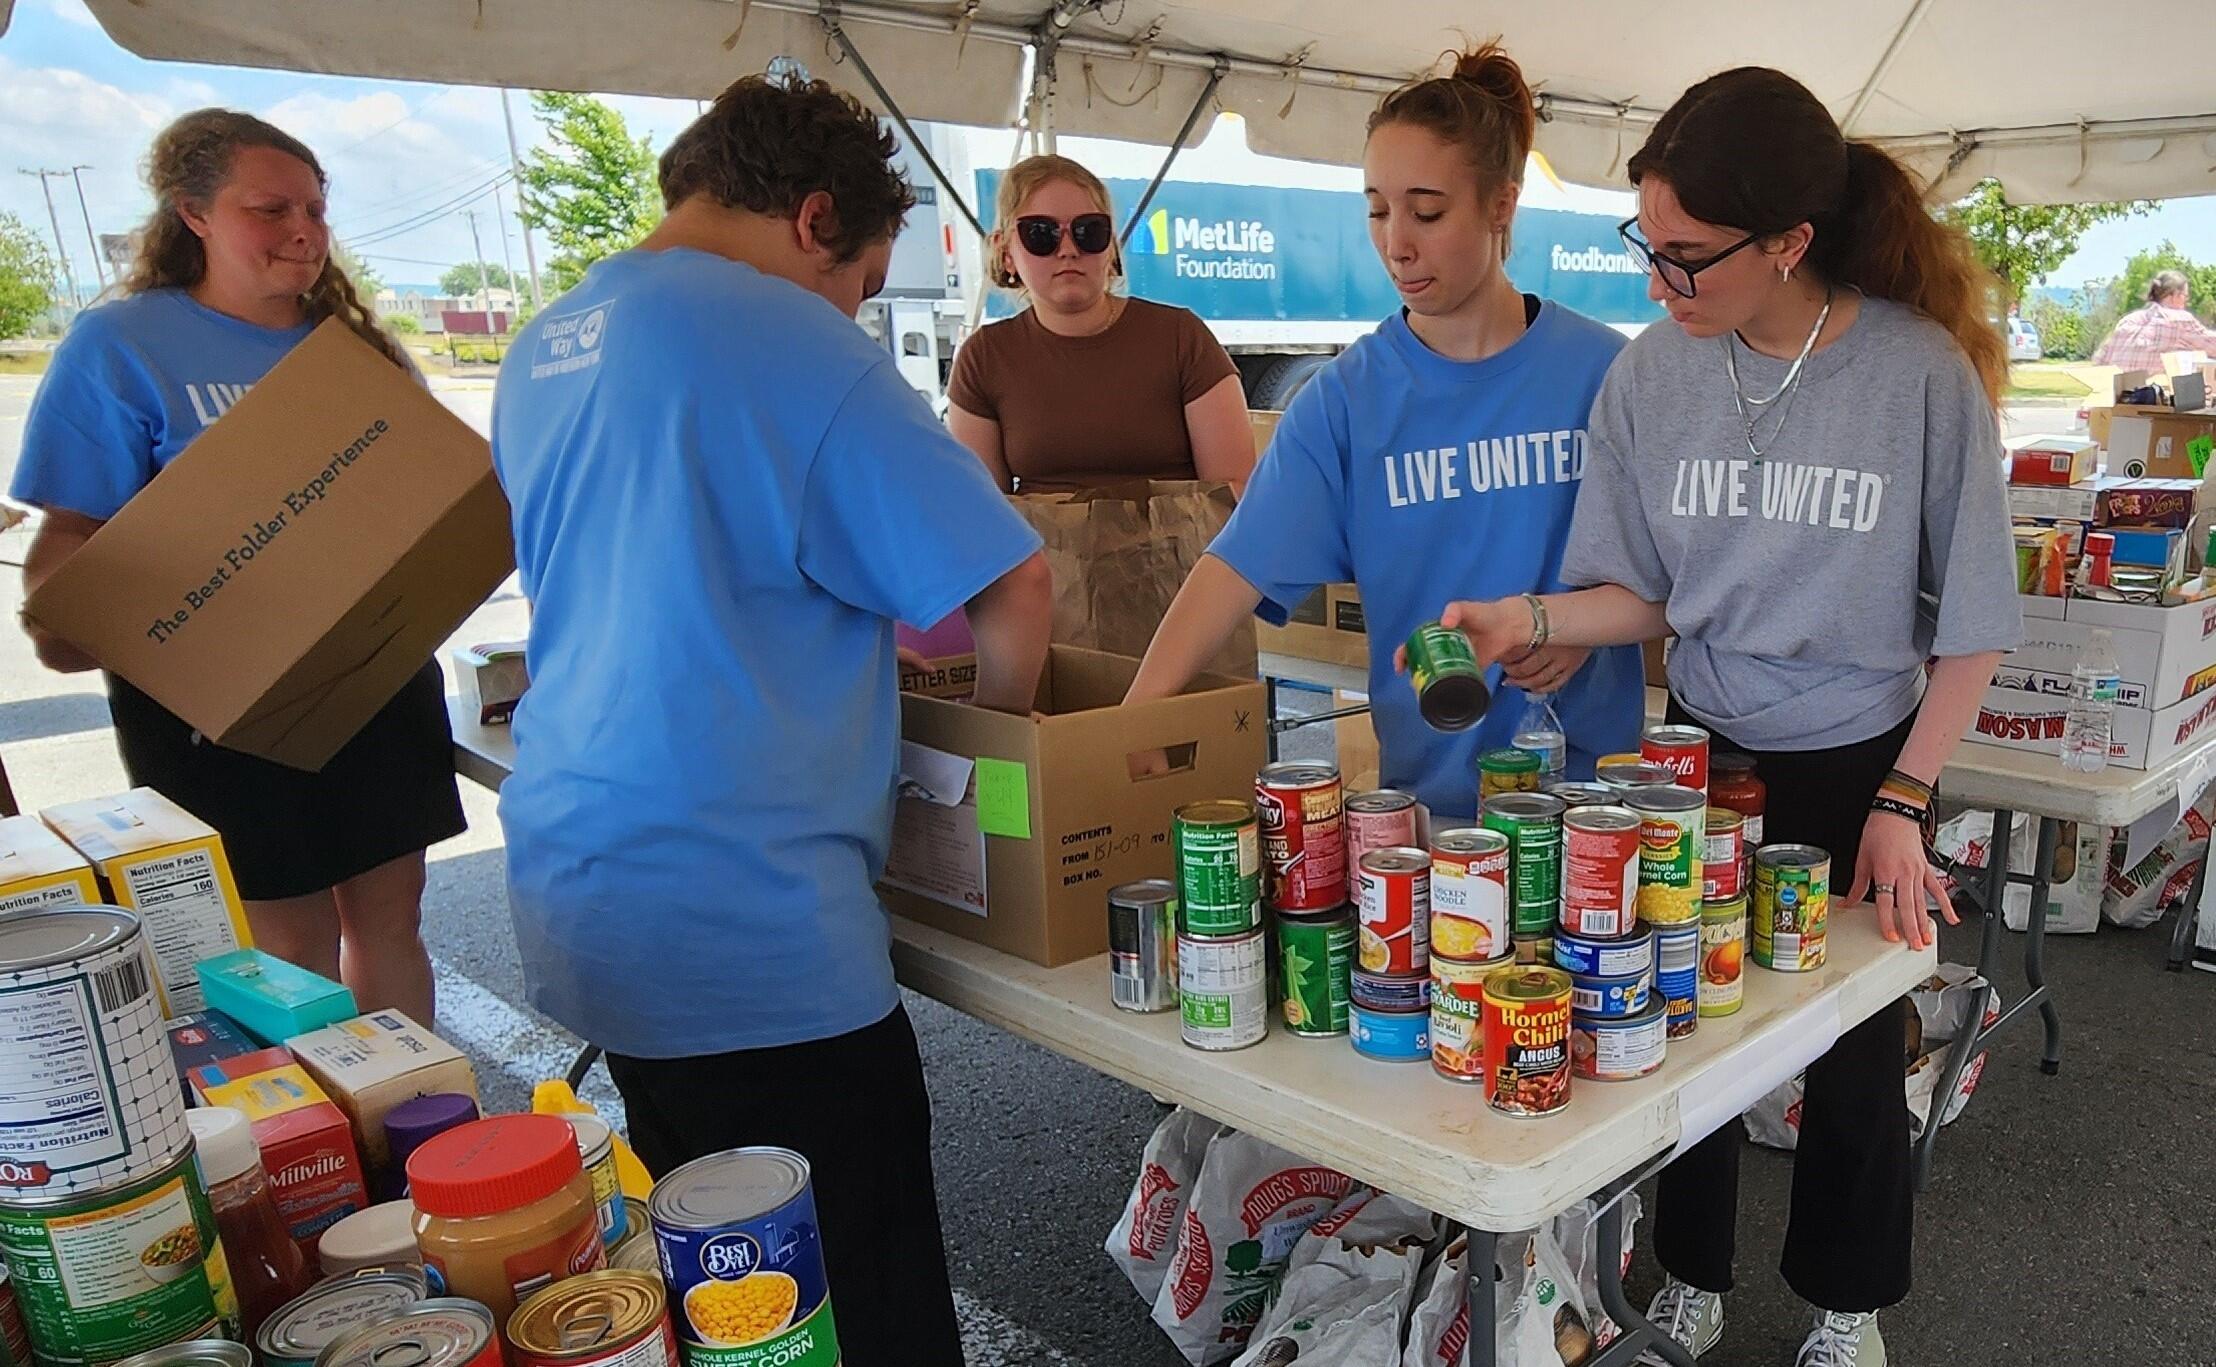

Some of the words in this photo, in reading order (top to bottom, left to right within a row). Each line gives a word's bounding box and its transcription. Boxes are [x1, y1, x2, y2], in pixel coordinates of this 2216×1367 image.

[1174, 217, 1275, 253] MetLife
[1176, 254, 1276, 281] Foundation
[185, 384, 254, 425] LIV
[1384, 447, 1461, 507] LIVE
[1467, 429, 1588, 493] UNITED
[1671, 459, 1749, 517] LIVE
[1760, 461, 1885, 532] UNITED
[147, 608, 189, 644] The
[184, 567, 231, 611] Best
[223, 511, 287, 572] Folder
[283, 418, 389, 517] Experience
[900, 670, 947, 692] ETTER
[1975, 711, 2067, 740] MASON
[1061, 825, 1112, 845] CONTENTS
[1152, 833, 1165, 844] TO
[1216, 831, 1237, 839] Facts
[1654, 828, 1679, 837] Monte
[130, 859, 175, 877] Nutrition
[177, 853, 204, 868] Facts
[1062, 851, 1089, 865] FROM
[1643, 861, 1675, 872] Whole
[193, 879, 213, 892] 160
[1063, 873, 1083, 886] BOX
[1085, 868, 1102, 881] NO.
[1663, 871, 1687, 880] Corn
[0, 895, 40, 911] utrition
[42, 887, 73, 900] Facts
[139, 892, 175, 906] Calories
[1431, 990, 1479, 1018] YARDEE
[1501, 999, 1570, 1027] Hormel
[1513, 1022, 1563, 1046] Chili
[1519, 1046, 1561, 1062] ANGUS
[45, 1090, 100, 1109] Calories
[40, 1127, 109, 1149] Nutrition
[269, 1153, 347, 1189] Millville
[1247, 1175, 1296, 1222] DOUG'S
[7, 1224, 45, 1236] Facts
[1147, 1197, 1180, 1252] POTATOES
[708, 1241, 749, 1274] BEST
[38, 1266, 56, 1279] 60
[690, 1351, 722, 1363] WHOLE
[724, 1347, 767, 1363] KERNEL
[768, 1328, 808, 1352] GOLDEN
[757, 1335, 814, 1367] CORN
